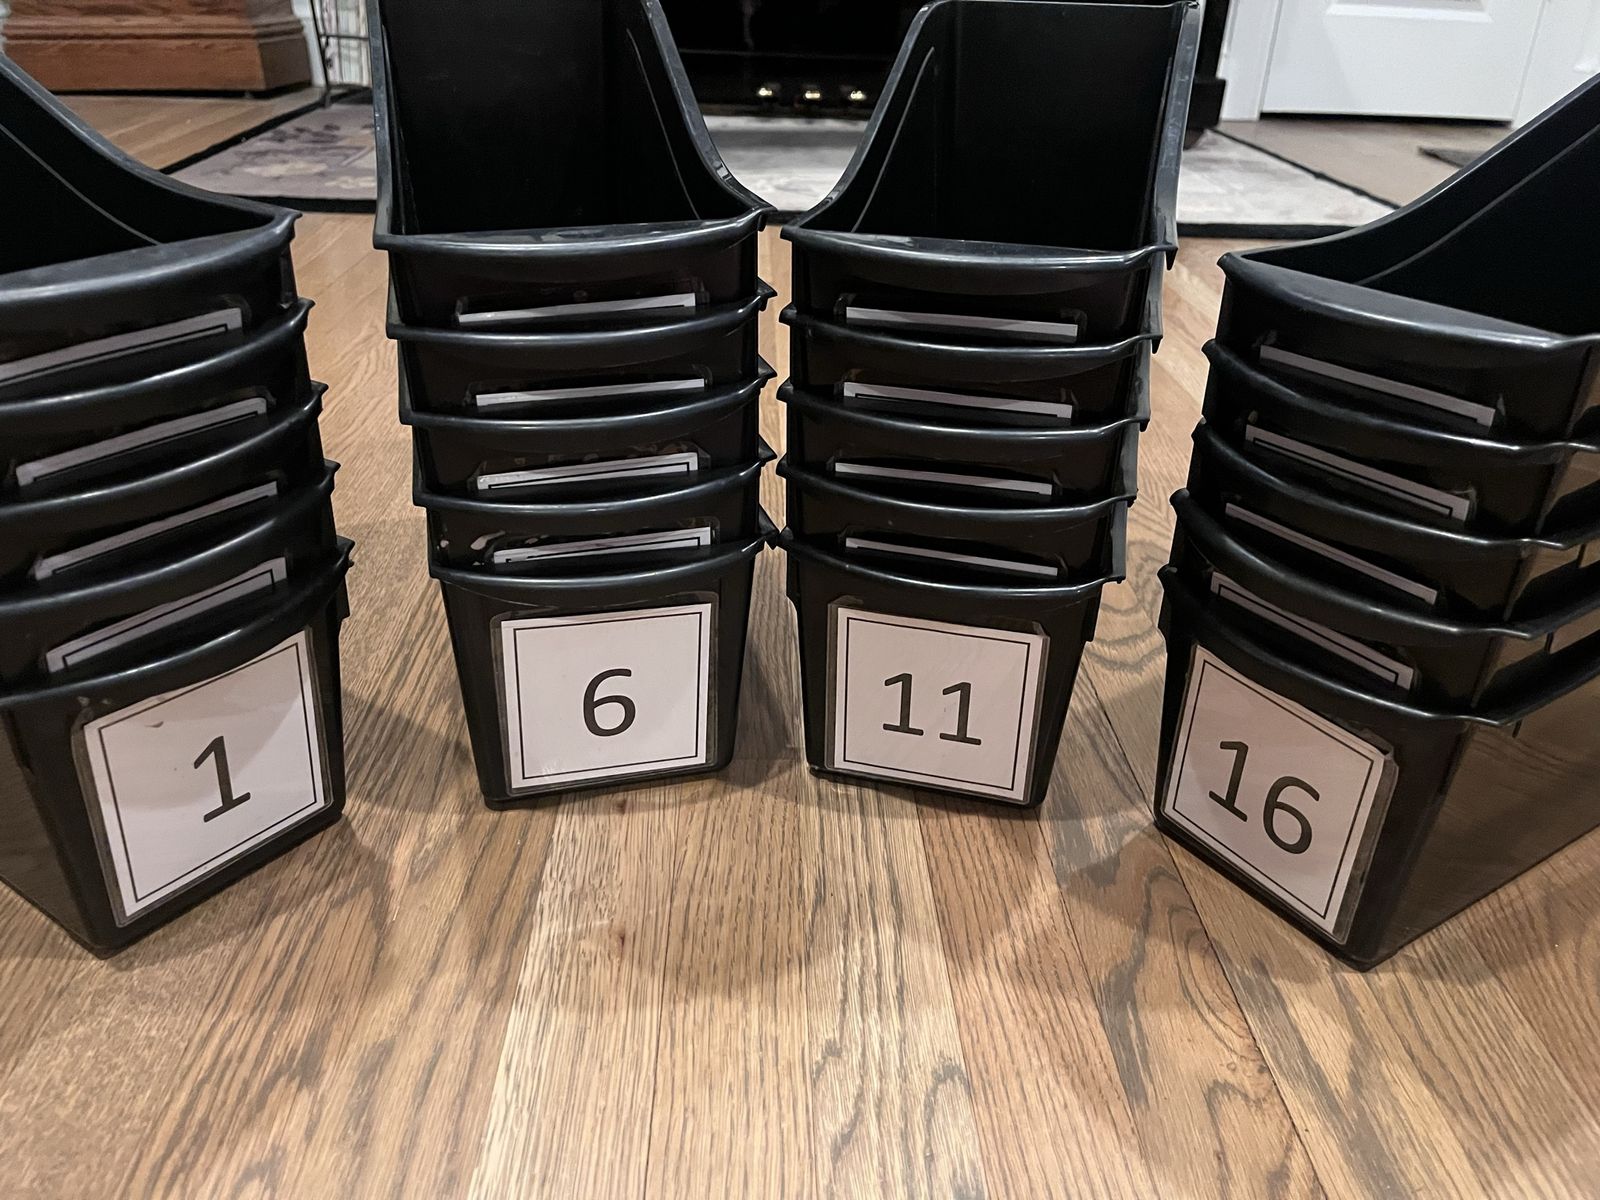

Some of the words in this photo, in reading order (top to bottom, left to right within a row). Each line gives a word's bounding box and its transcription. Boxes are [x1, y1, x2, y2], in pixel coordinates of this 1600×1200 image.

[582, 668, 636, 737] 6
[882, 672, 982, 746] 11
[192, 735, 252, 823] 1
[1208, 740, 1321, 855] 16
